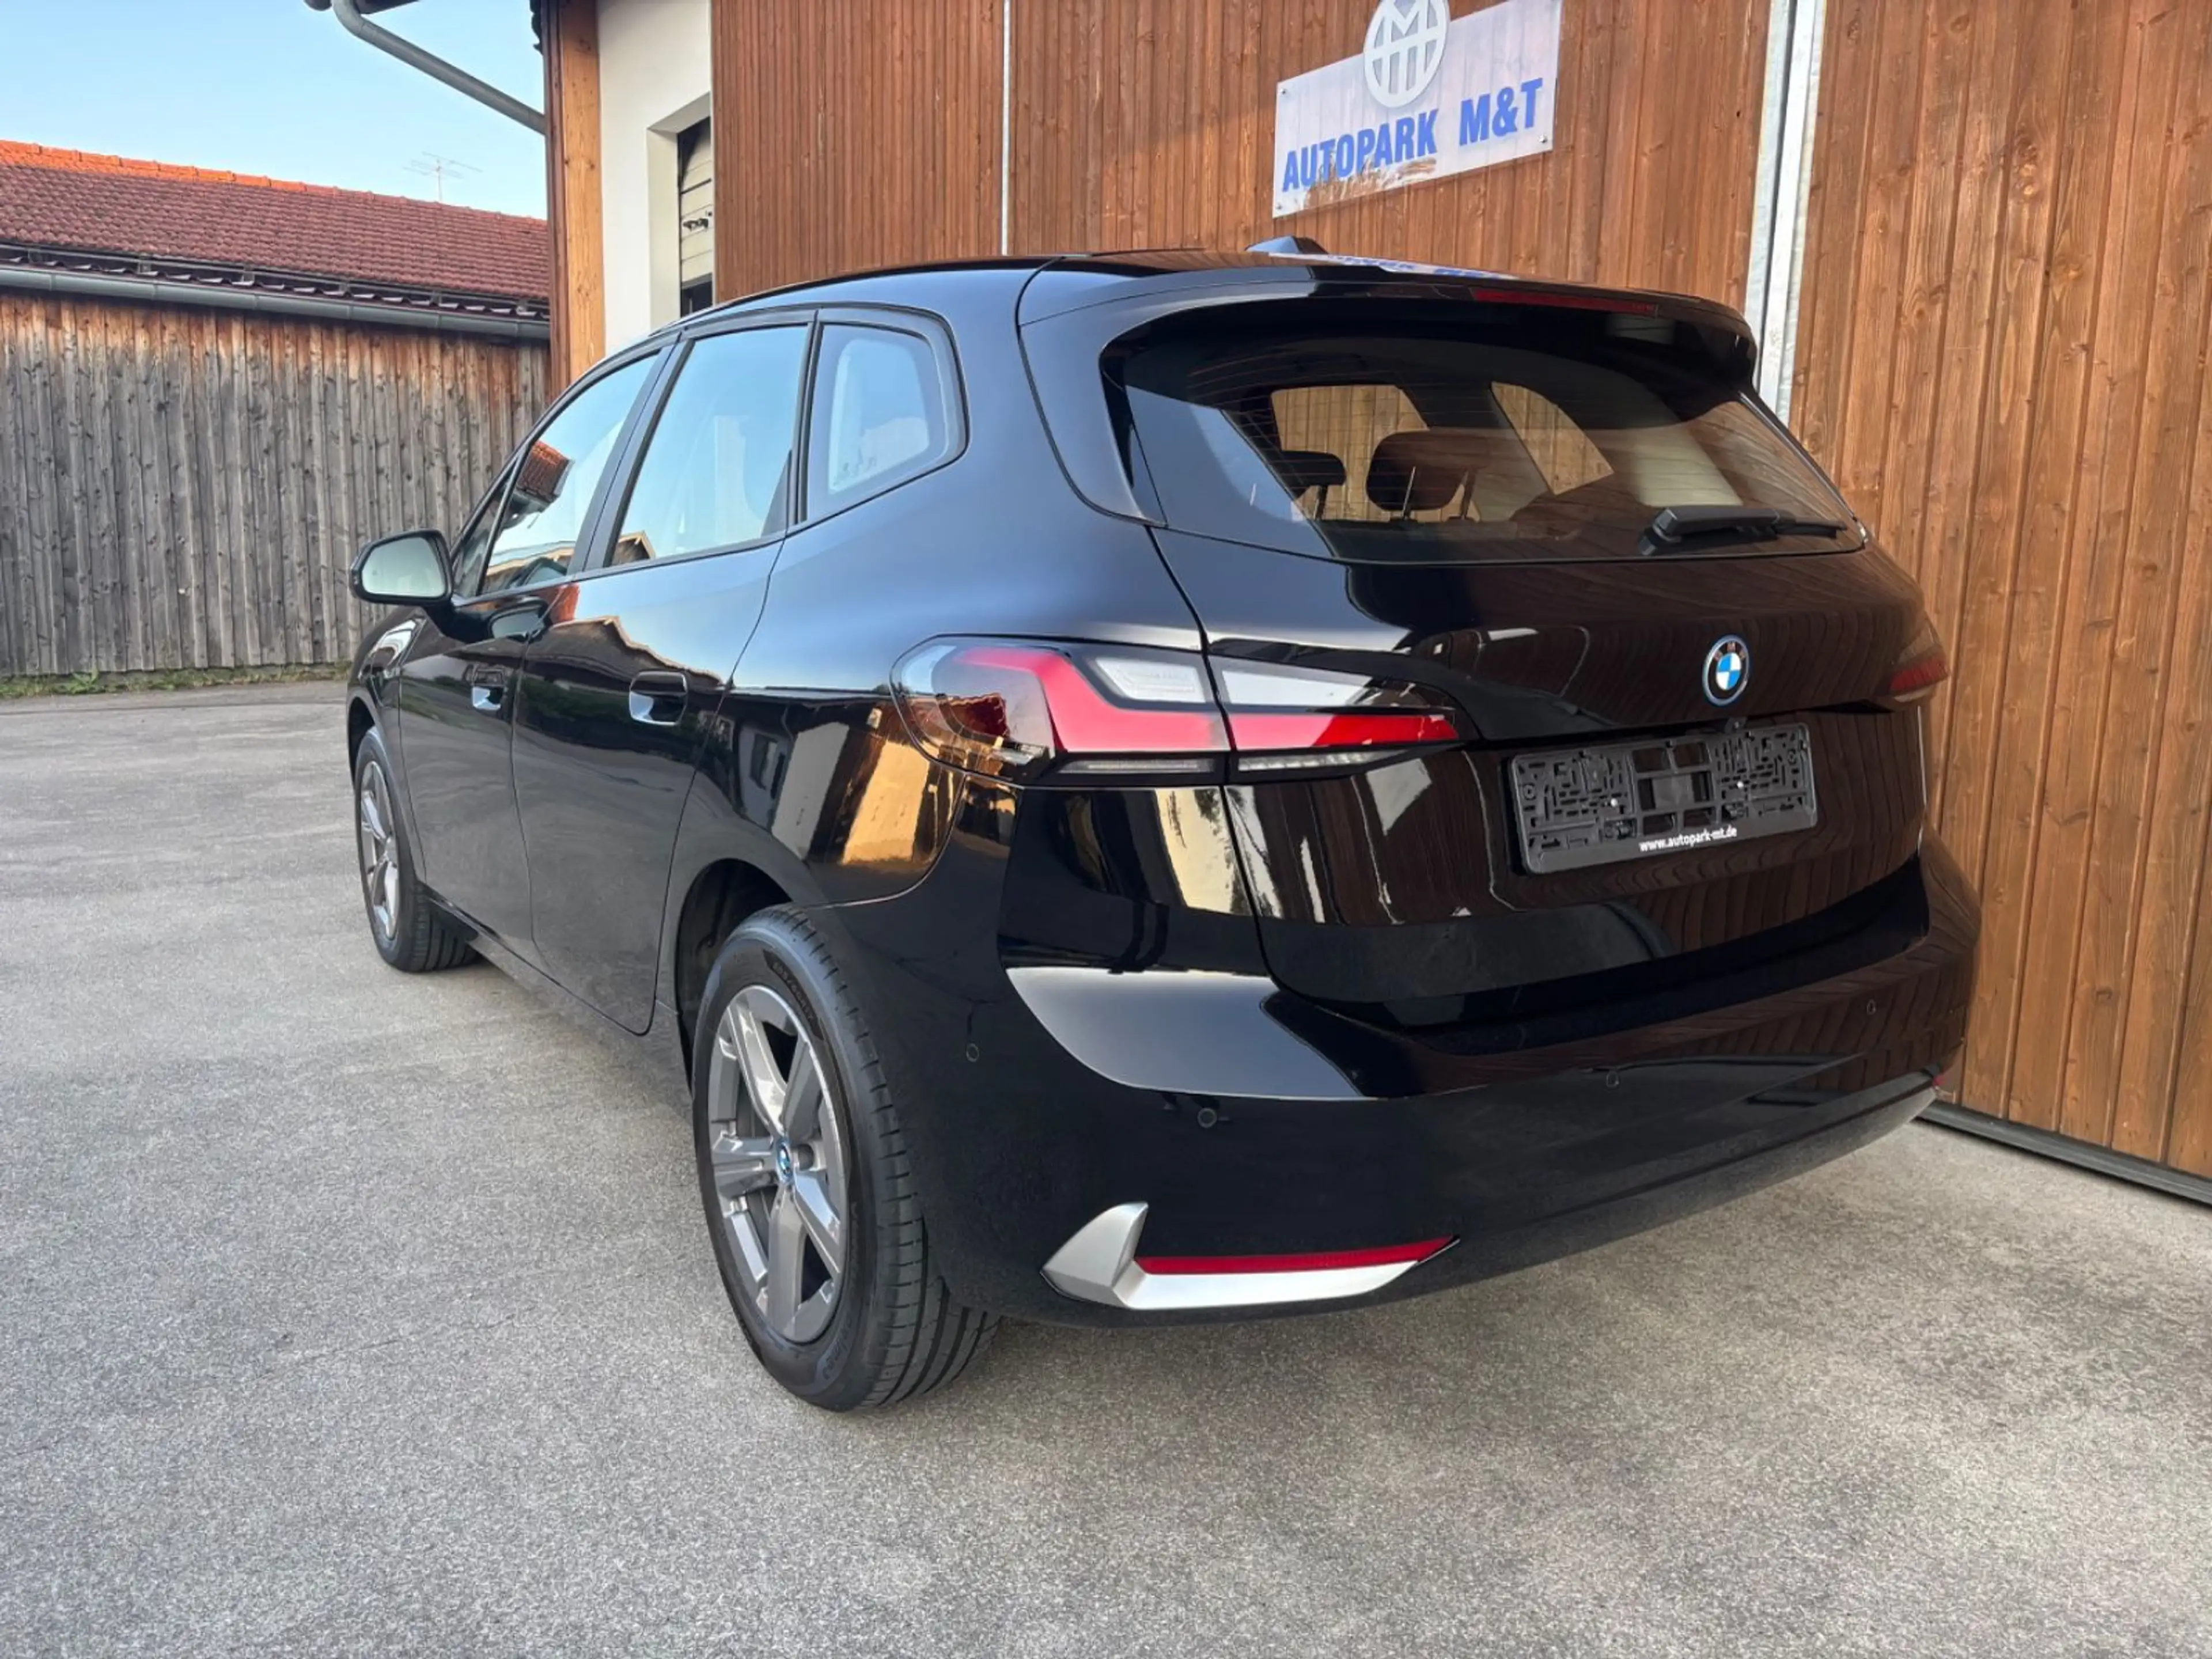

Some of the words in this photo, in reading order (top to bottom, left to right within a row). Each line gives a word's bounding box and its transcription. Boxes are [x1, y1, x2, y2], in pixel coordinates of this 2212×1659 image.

[1282, 108, 1439, 192] AUTOPARK
[1459, 77, 1544, 146] M&T
[1639, 824, 1737, 852] www.autopark-mt.de
